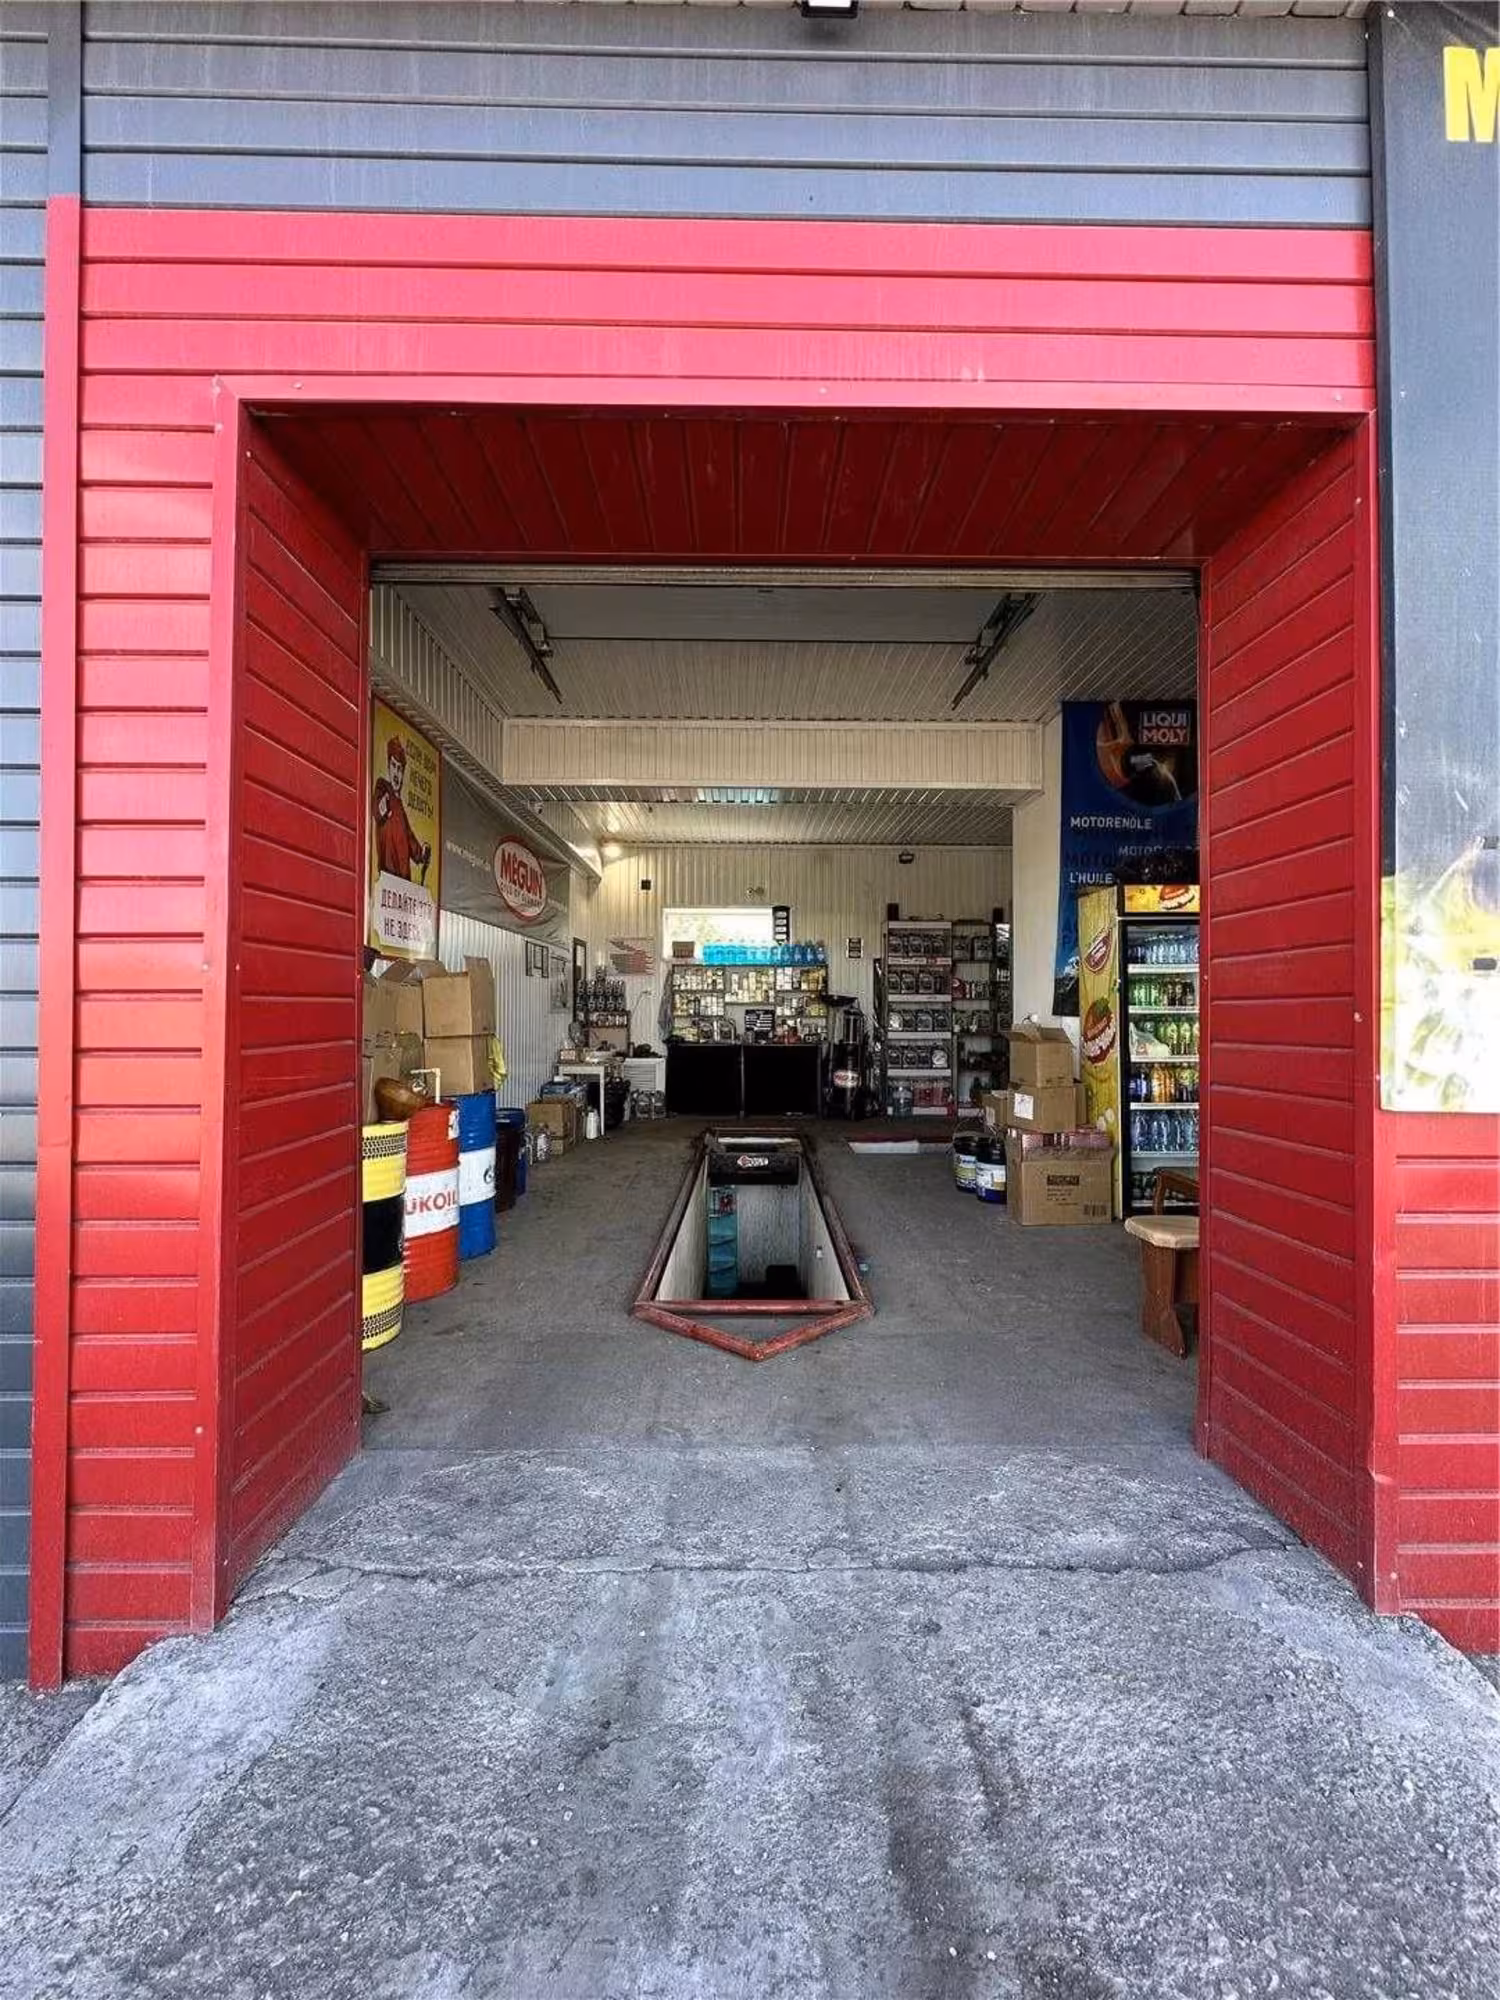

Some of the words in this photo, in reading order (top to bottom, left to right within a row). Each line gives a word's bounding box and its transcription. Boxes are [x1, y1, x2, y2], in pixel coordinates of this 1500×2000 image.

[1143, 712, 1187, 728] LIQUI
[1142, 728, 1187, 743] MOLY
[1069, 871, 1113, 884] L'HUILE
[384, 916, 395, 937] НЕ
